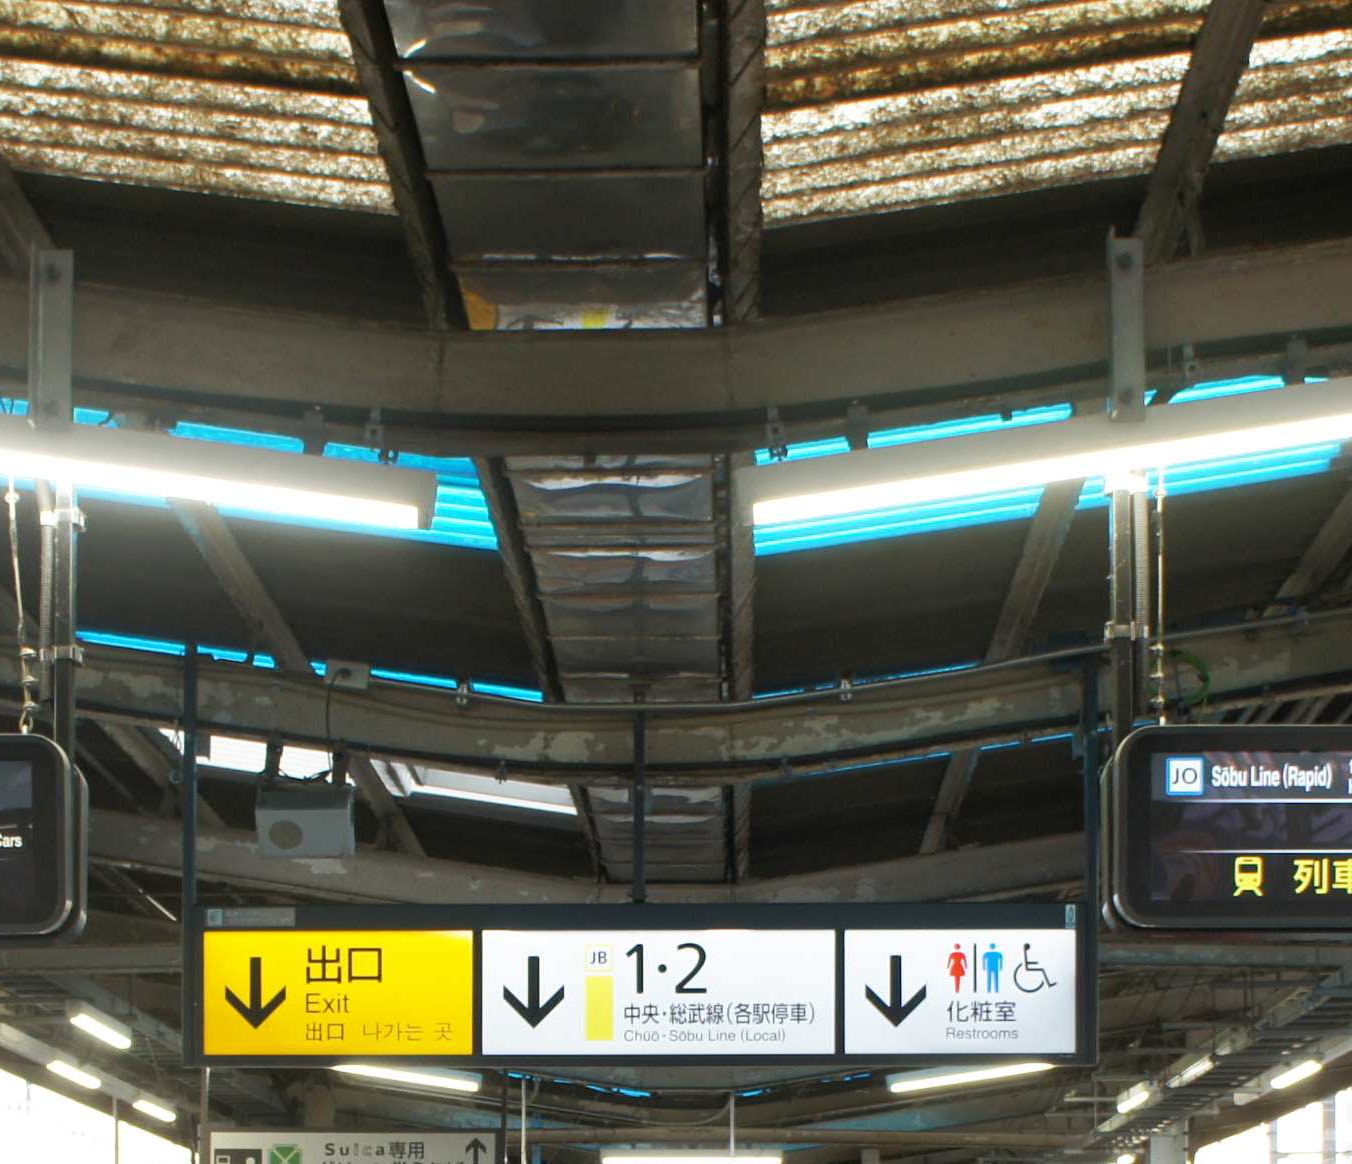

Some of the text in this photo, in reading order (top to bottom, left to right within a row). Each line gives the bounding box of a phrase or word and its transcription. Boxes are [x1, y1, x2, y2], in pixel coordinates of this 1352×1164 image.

[1172, 767, 1198, 785] JO
[1211, 762, 1333, 792] Sōbu Line (Rapid)
[305, 945, 383, 984] 出口
[589, 951, 609, 966] JB
[305, 992, 349, 1014] Exit
[947, 1000, 1016, 1023] 化粧室
[305, 1022, 345, 1042] 出口
[362, 1021, 453, 1042] 나가는 곳
[945, 1027, 1019, 1040] Restrooms
